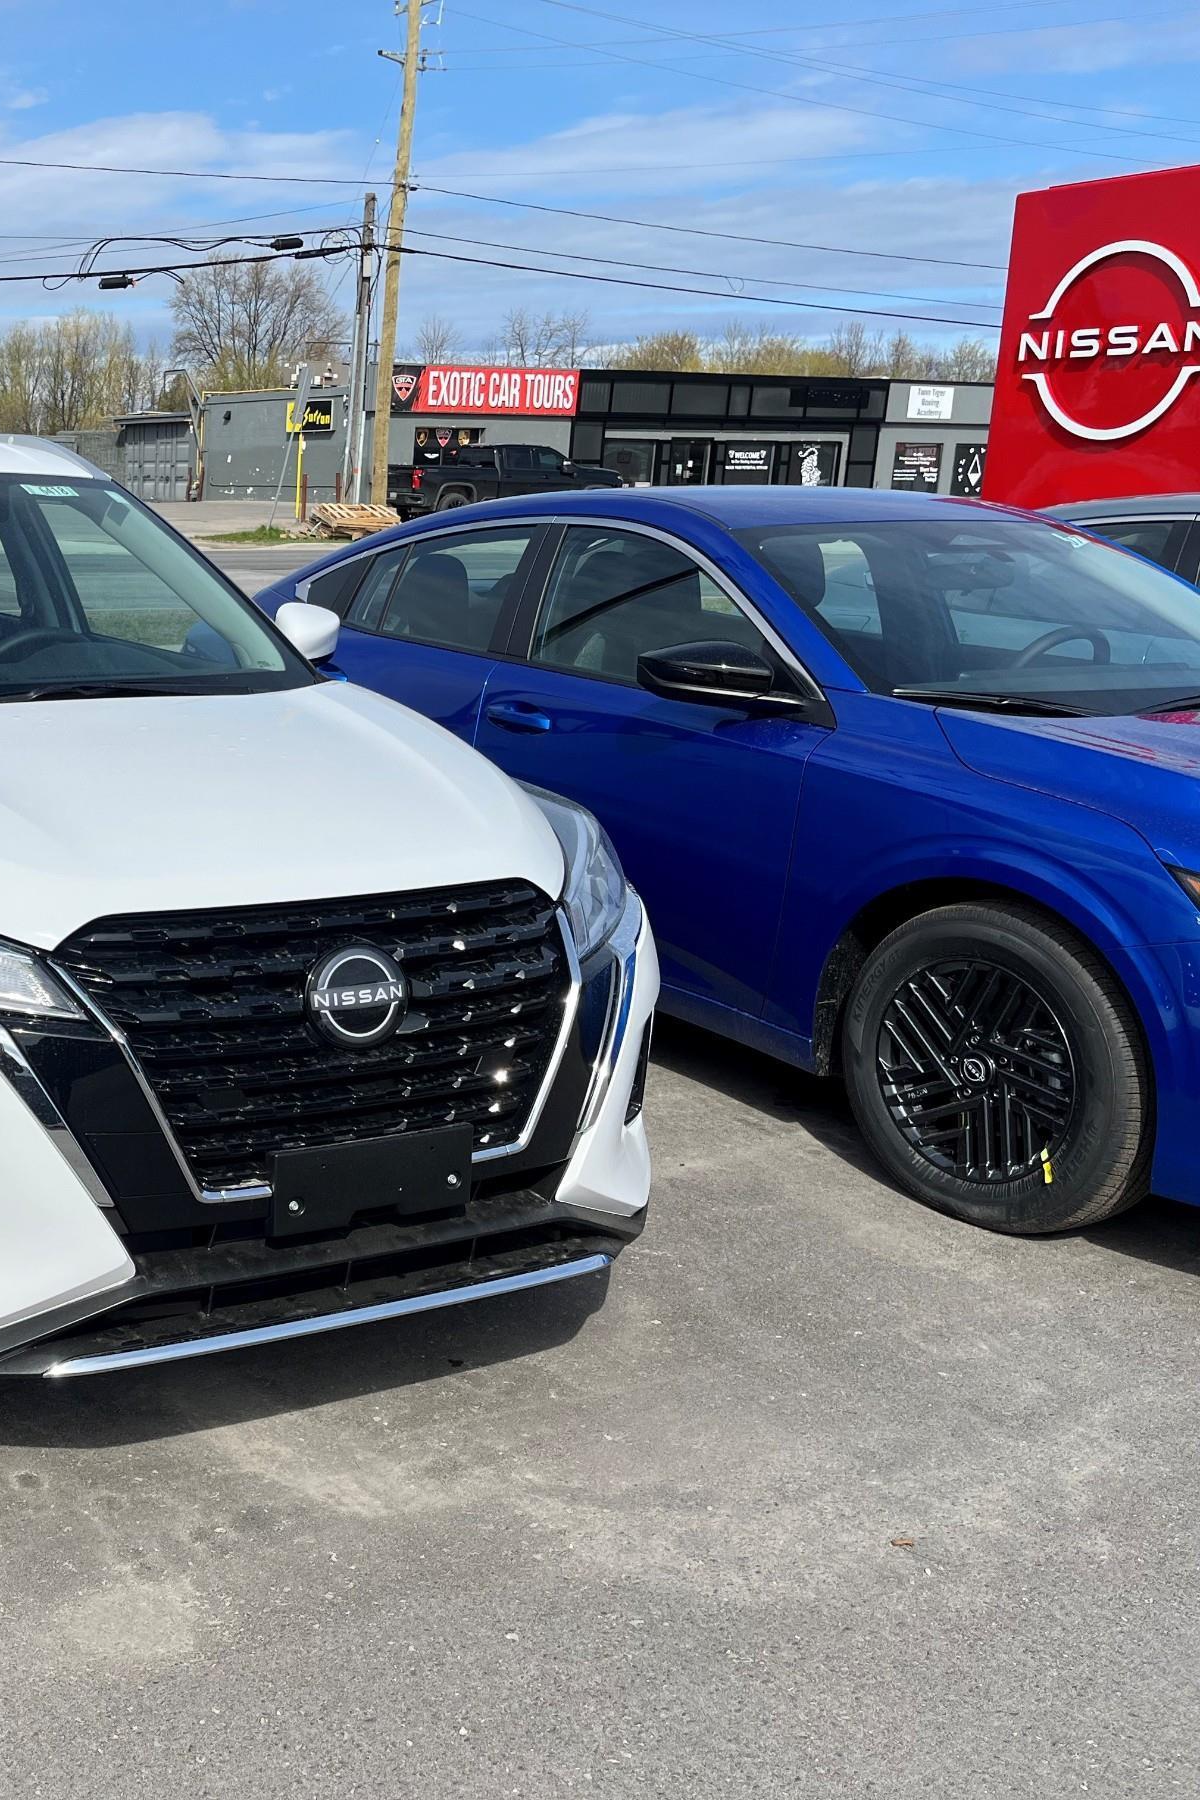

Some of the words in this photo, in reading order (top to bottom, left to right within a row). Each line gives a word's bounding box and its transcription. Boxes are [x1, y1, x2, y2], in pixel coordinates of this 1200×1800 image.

[427, 370, 486, 407] EXOTIC
[488, 372, 521, 408] CAR
[524, 373, 576, 410] TOURS
[916, 408, 942, 419] Academy
[734, 451, 760, 459] WELCOME
[313, 984, 403, 1008] NISSAN
